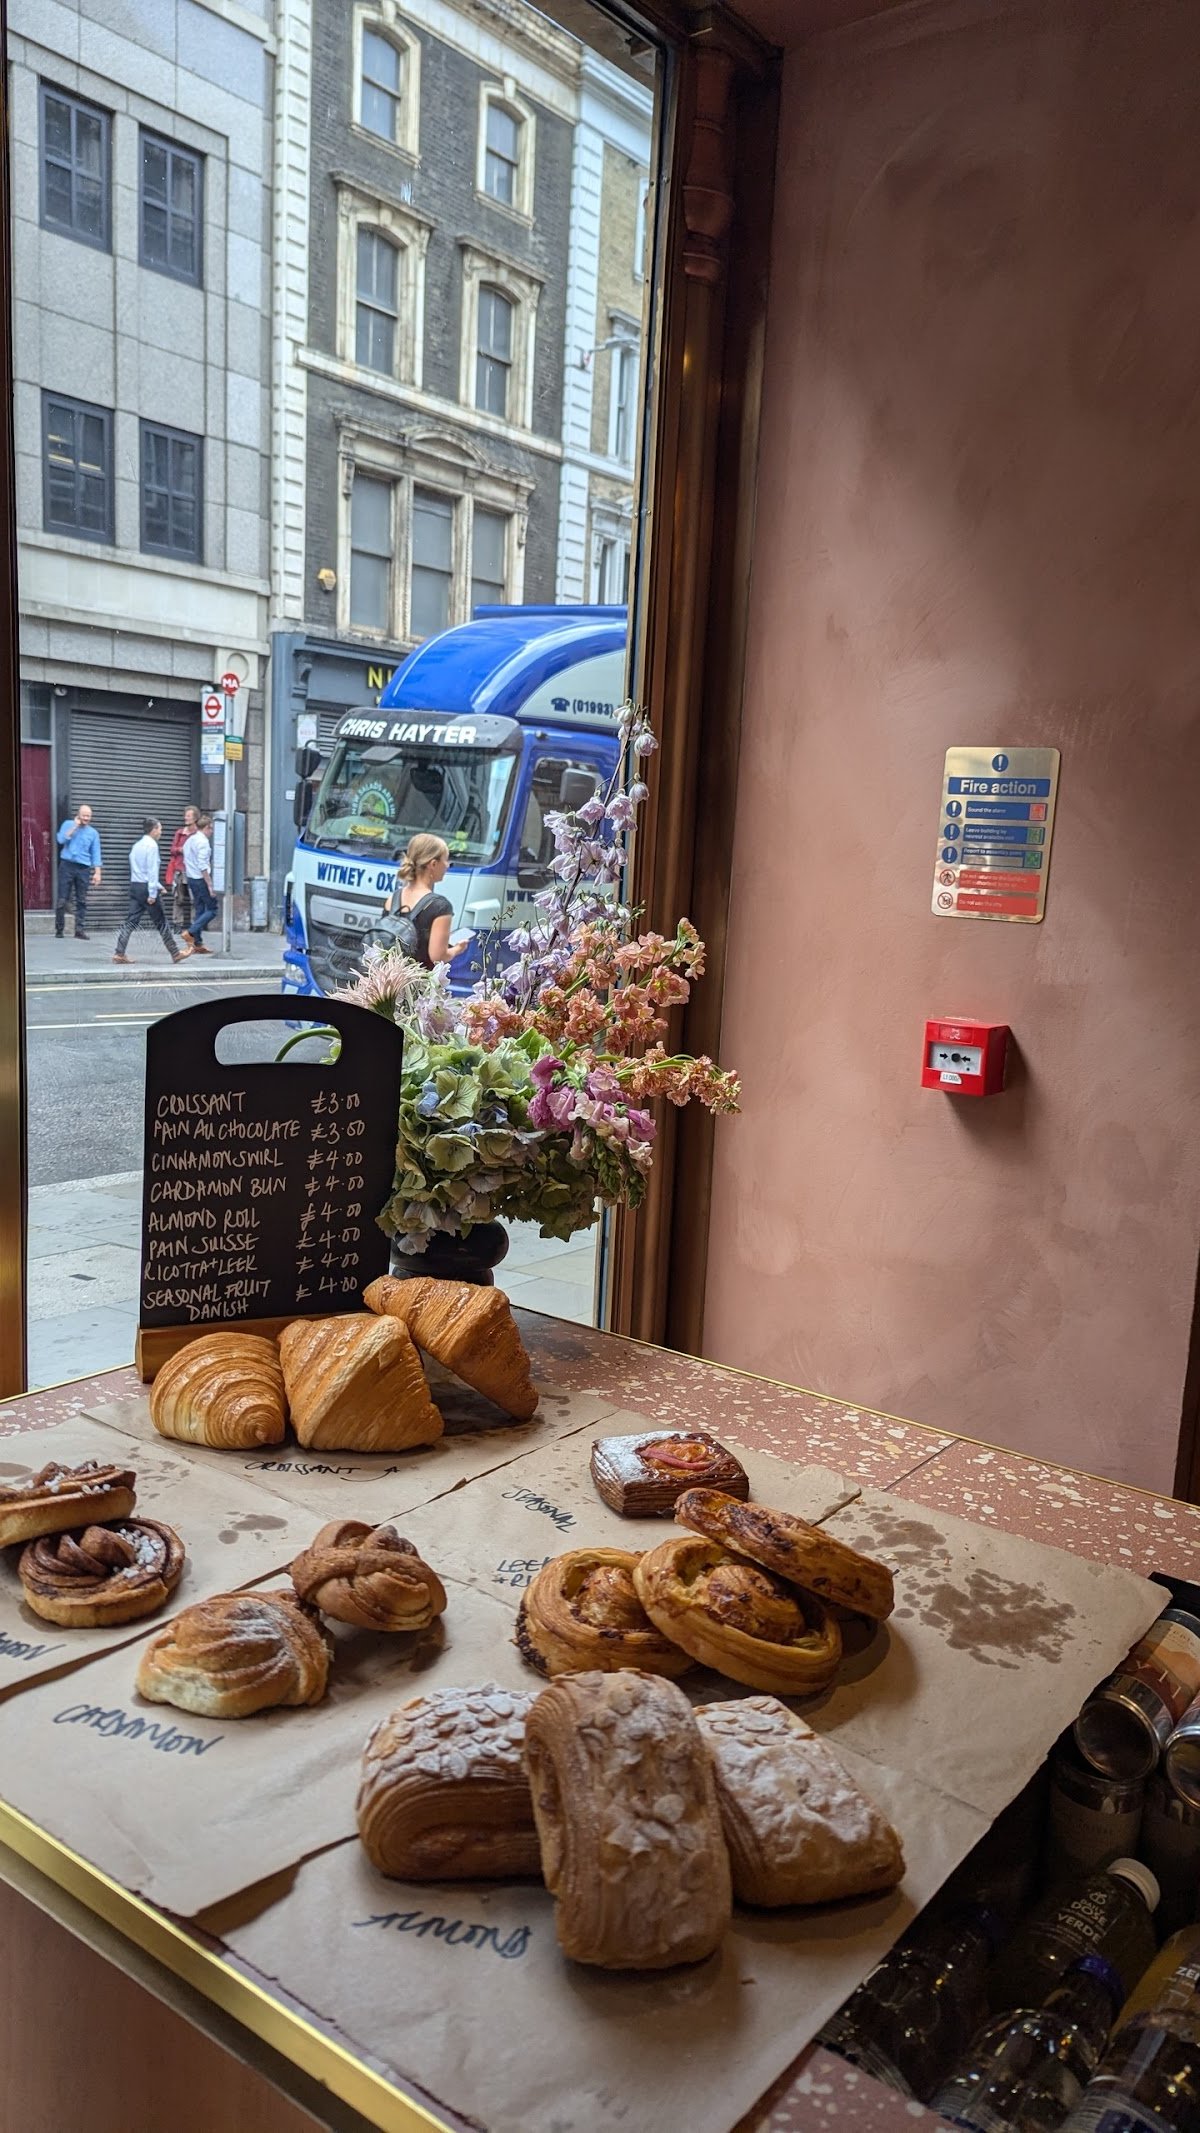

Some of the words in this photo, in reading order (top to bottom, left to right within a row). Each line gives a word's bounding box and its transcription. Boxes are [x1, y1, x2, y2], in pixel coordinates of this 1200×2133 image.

[222, 678, 238, 689] MA
[339, 718, 388, 739] CHRIS
[388, 722, 477, 744] HAYTER
[960, 779, 988, 794] Fire
[991, 780, 1037, 795] action
[317, 862, 366, 887] WITNEY
[343, 913, 380, 929] DA
[157, 1091, 246, 1118] CROISSANT
[311, 1091, 361, 1114] £3.00
[153, 1119, 190, 1145] PAIN
[218, 1119, 301, 1142] CHOCOLATE
[311, 1120, 366, 1144] £3.50
[306, 1150, 363, 1170] £4.00
[151, 1176, 243, 1203] CARDAMON
[251, 1177, 287, 1198] BUN
[148, 1208, 216, 1232] ALMOND
[223, 1208, 261, 1232] ROLL
[150, 1236, 188, 1260] PAIN
[191, 1234, 260, 1255] SUISSE
[142, 1287, 222, 1310] SEASONAL
[225, 1279, 271, 1299] FRUIT
[186, 1298, 250, 1322] DANISH
[244, 1461, 362, 1476] CROISSANT
[501, 1488, 577, 1533] SEASONAL
[1070, 1901, 1108, 1926] DOSE
[1058, 1913, 1102, 1943] VERDE
